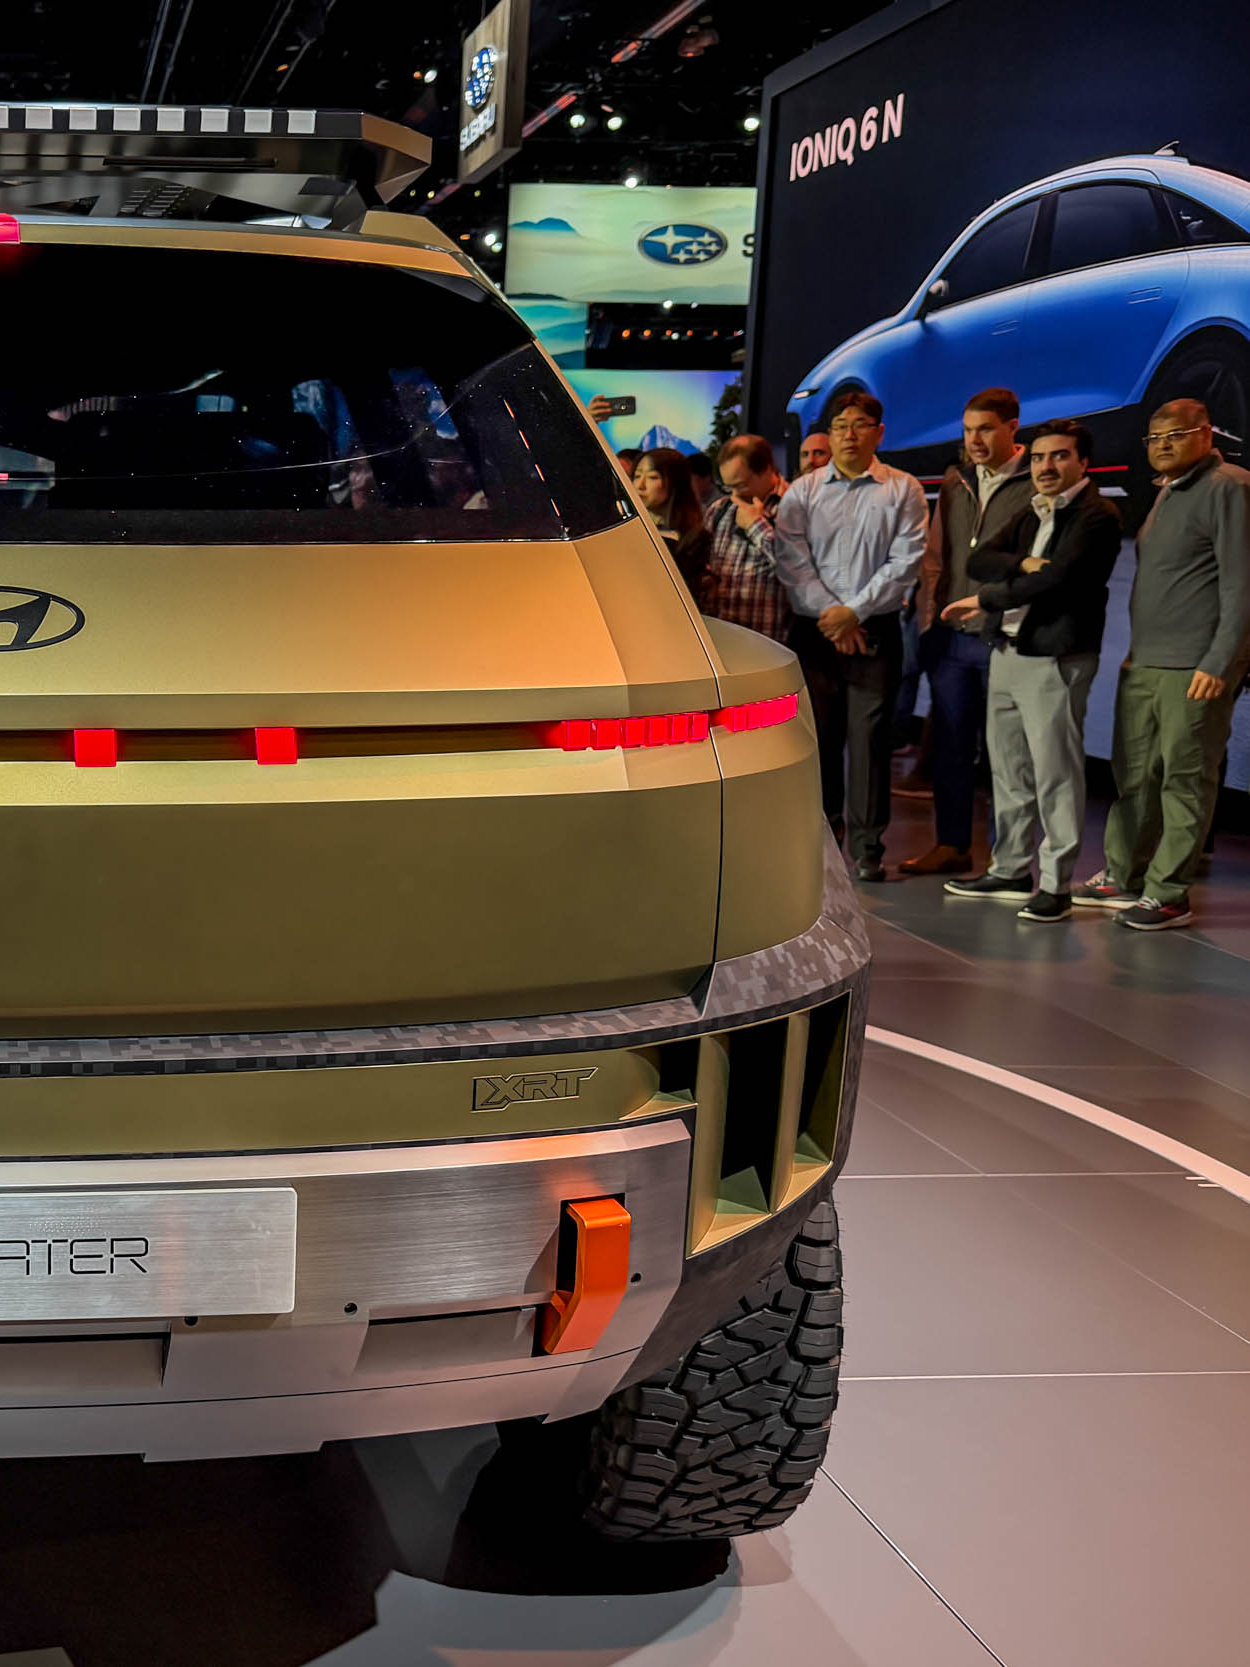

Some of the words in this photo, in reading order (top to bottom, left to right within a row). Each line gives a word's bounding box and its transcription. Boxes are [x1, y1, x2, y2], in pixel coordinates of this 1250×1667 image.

[790, 117, 857, 182] IONIQ
[860, 106, 879, 152] 6
[882, 93, 905, 143] N
[472, 1067, 598, 1112] XRT
